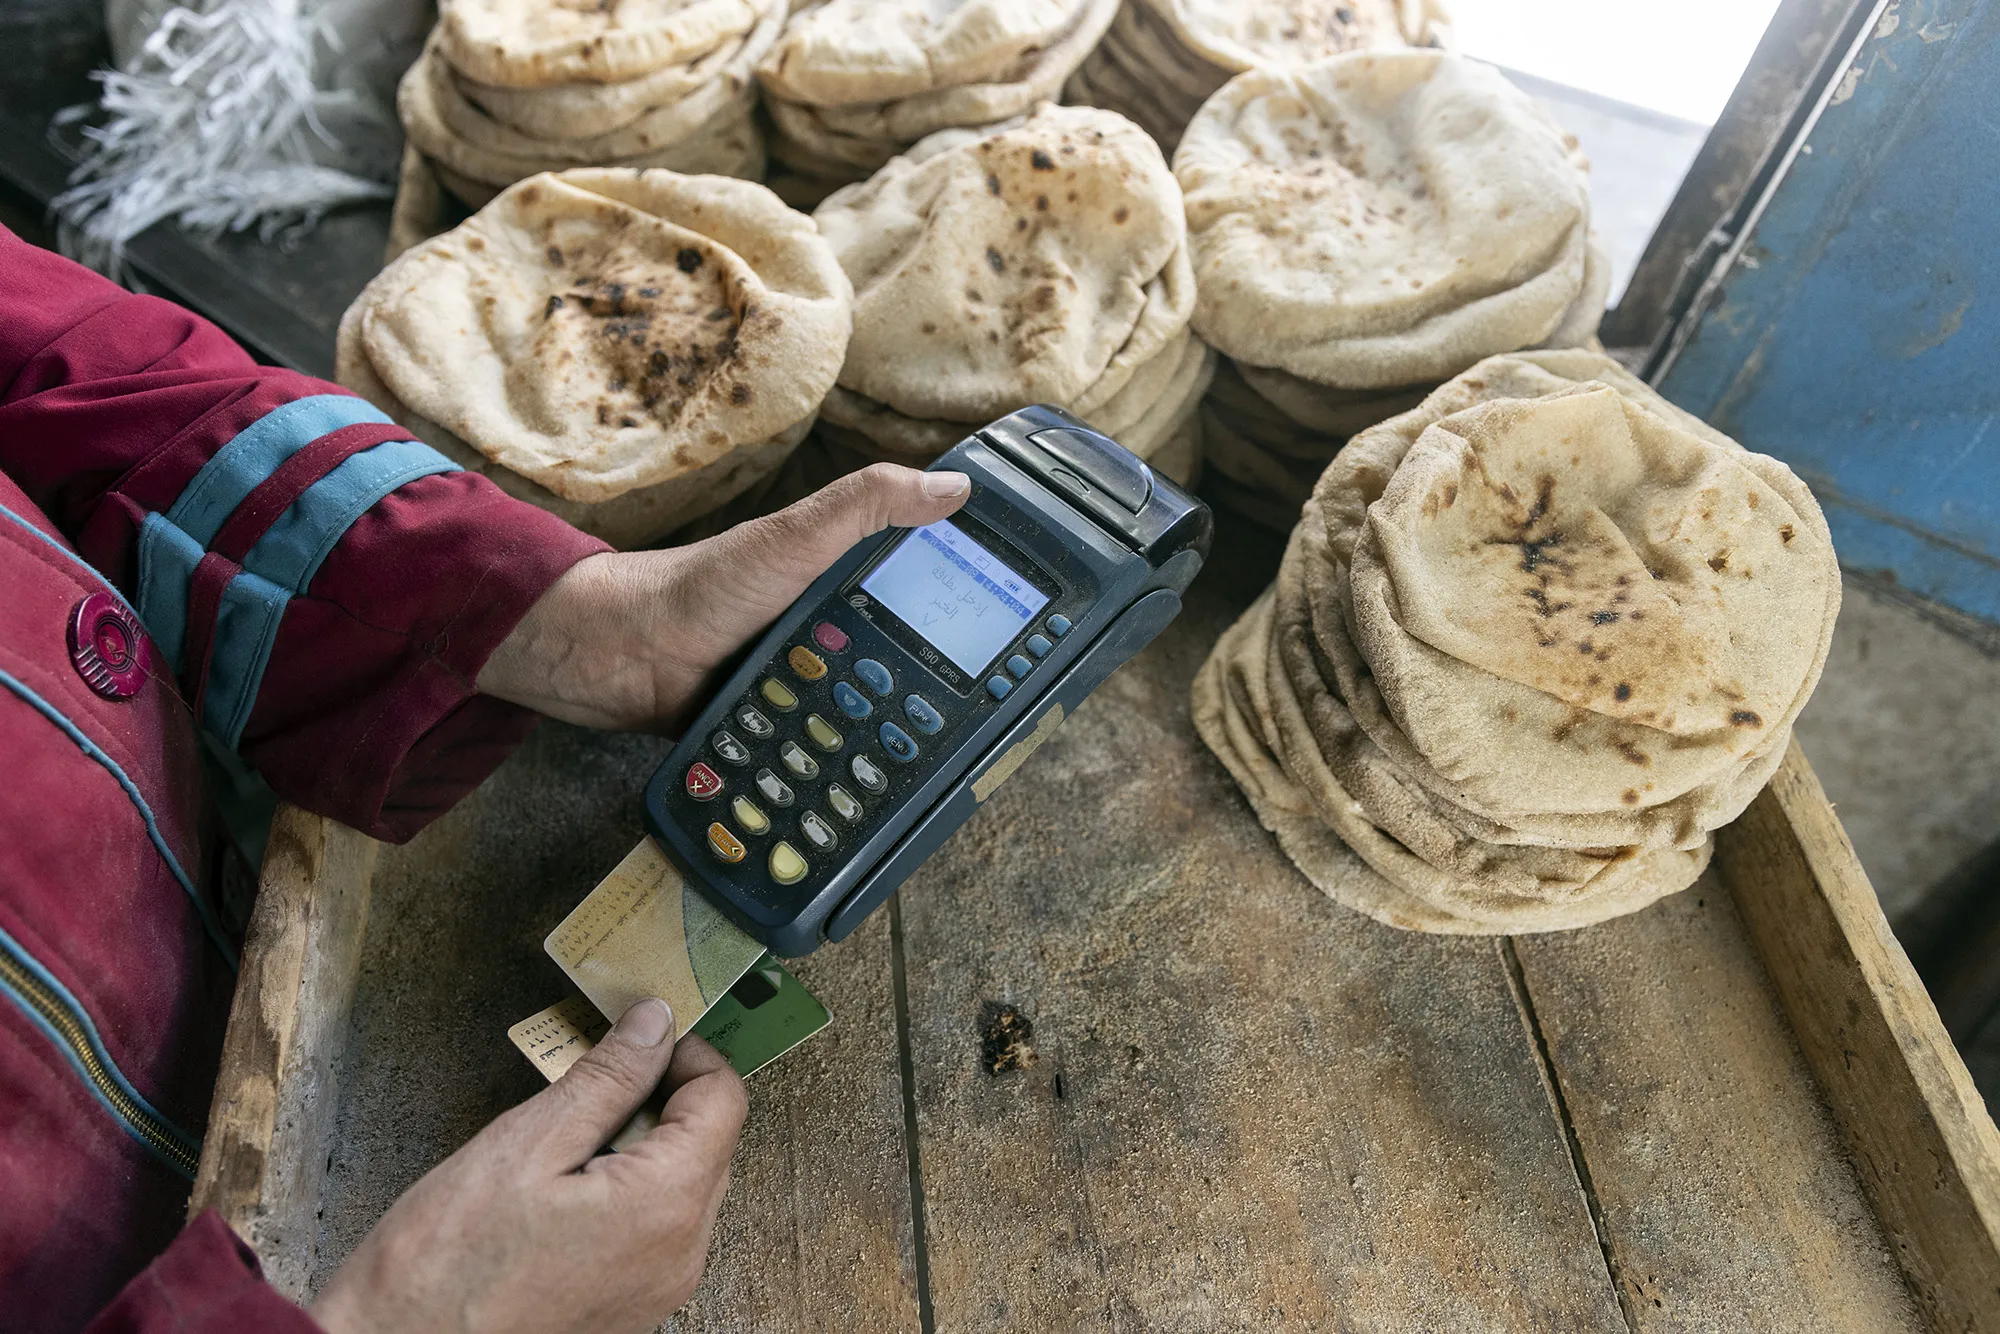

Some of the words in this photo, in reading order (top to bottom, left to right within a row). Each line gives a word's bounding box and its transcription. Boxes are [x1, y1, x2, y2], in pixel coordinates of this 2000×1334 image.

[931, 566, 957, 592] بطاقة
[919, 646, 939, 665] S90
[939, 664, 961, 684] GPRS
[692, 765, 716, 790] CANCEL
[708, 825, 733, 850] CLEAR
